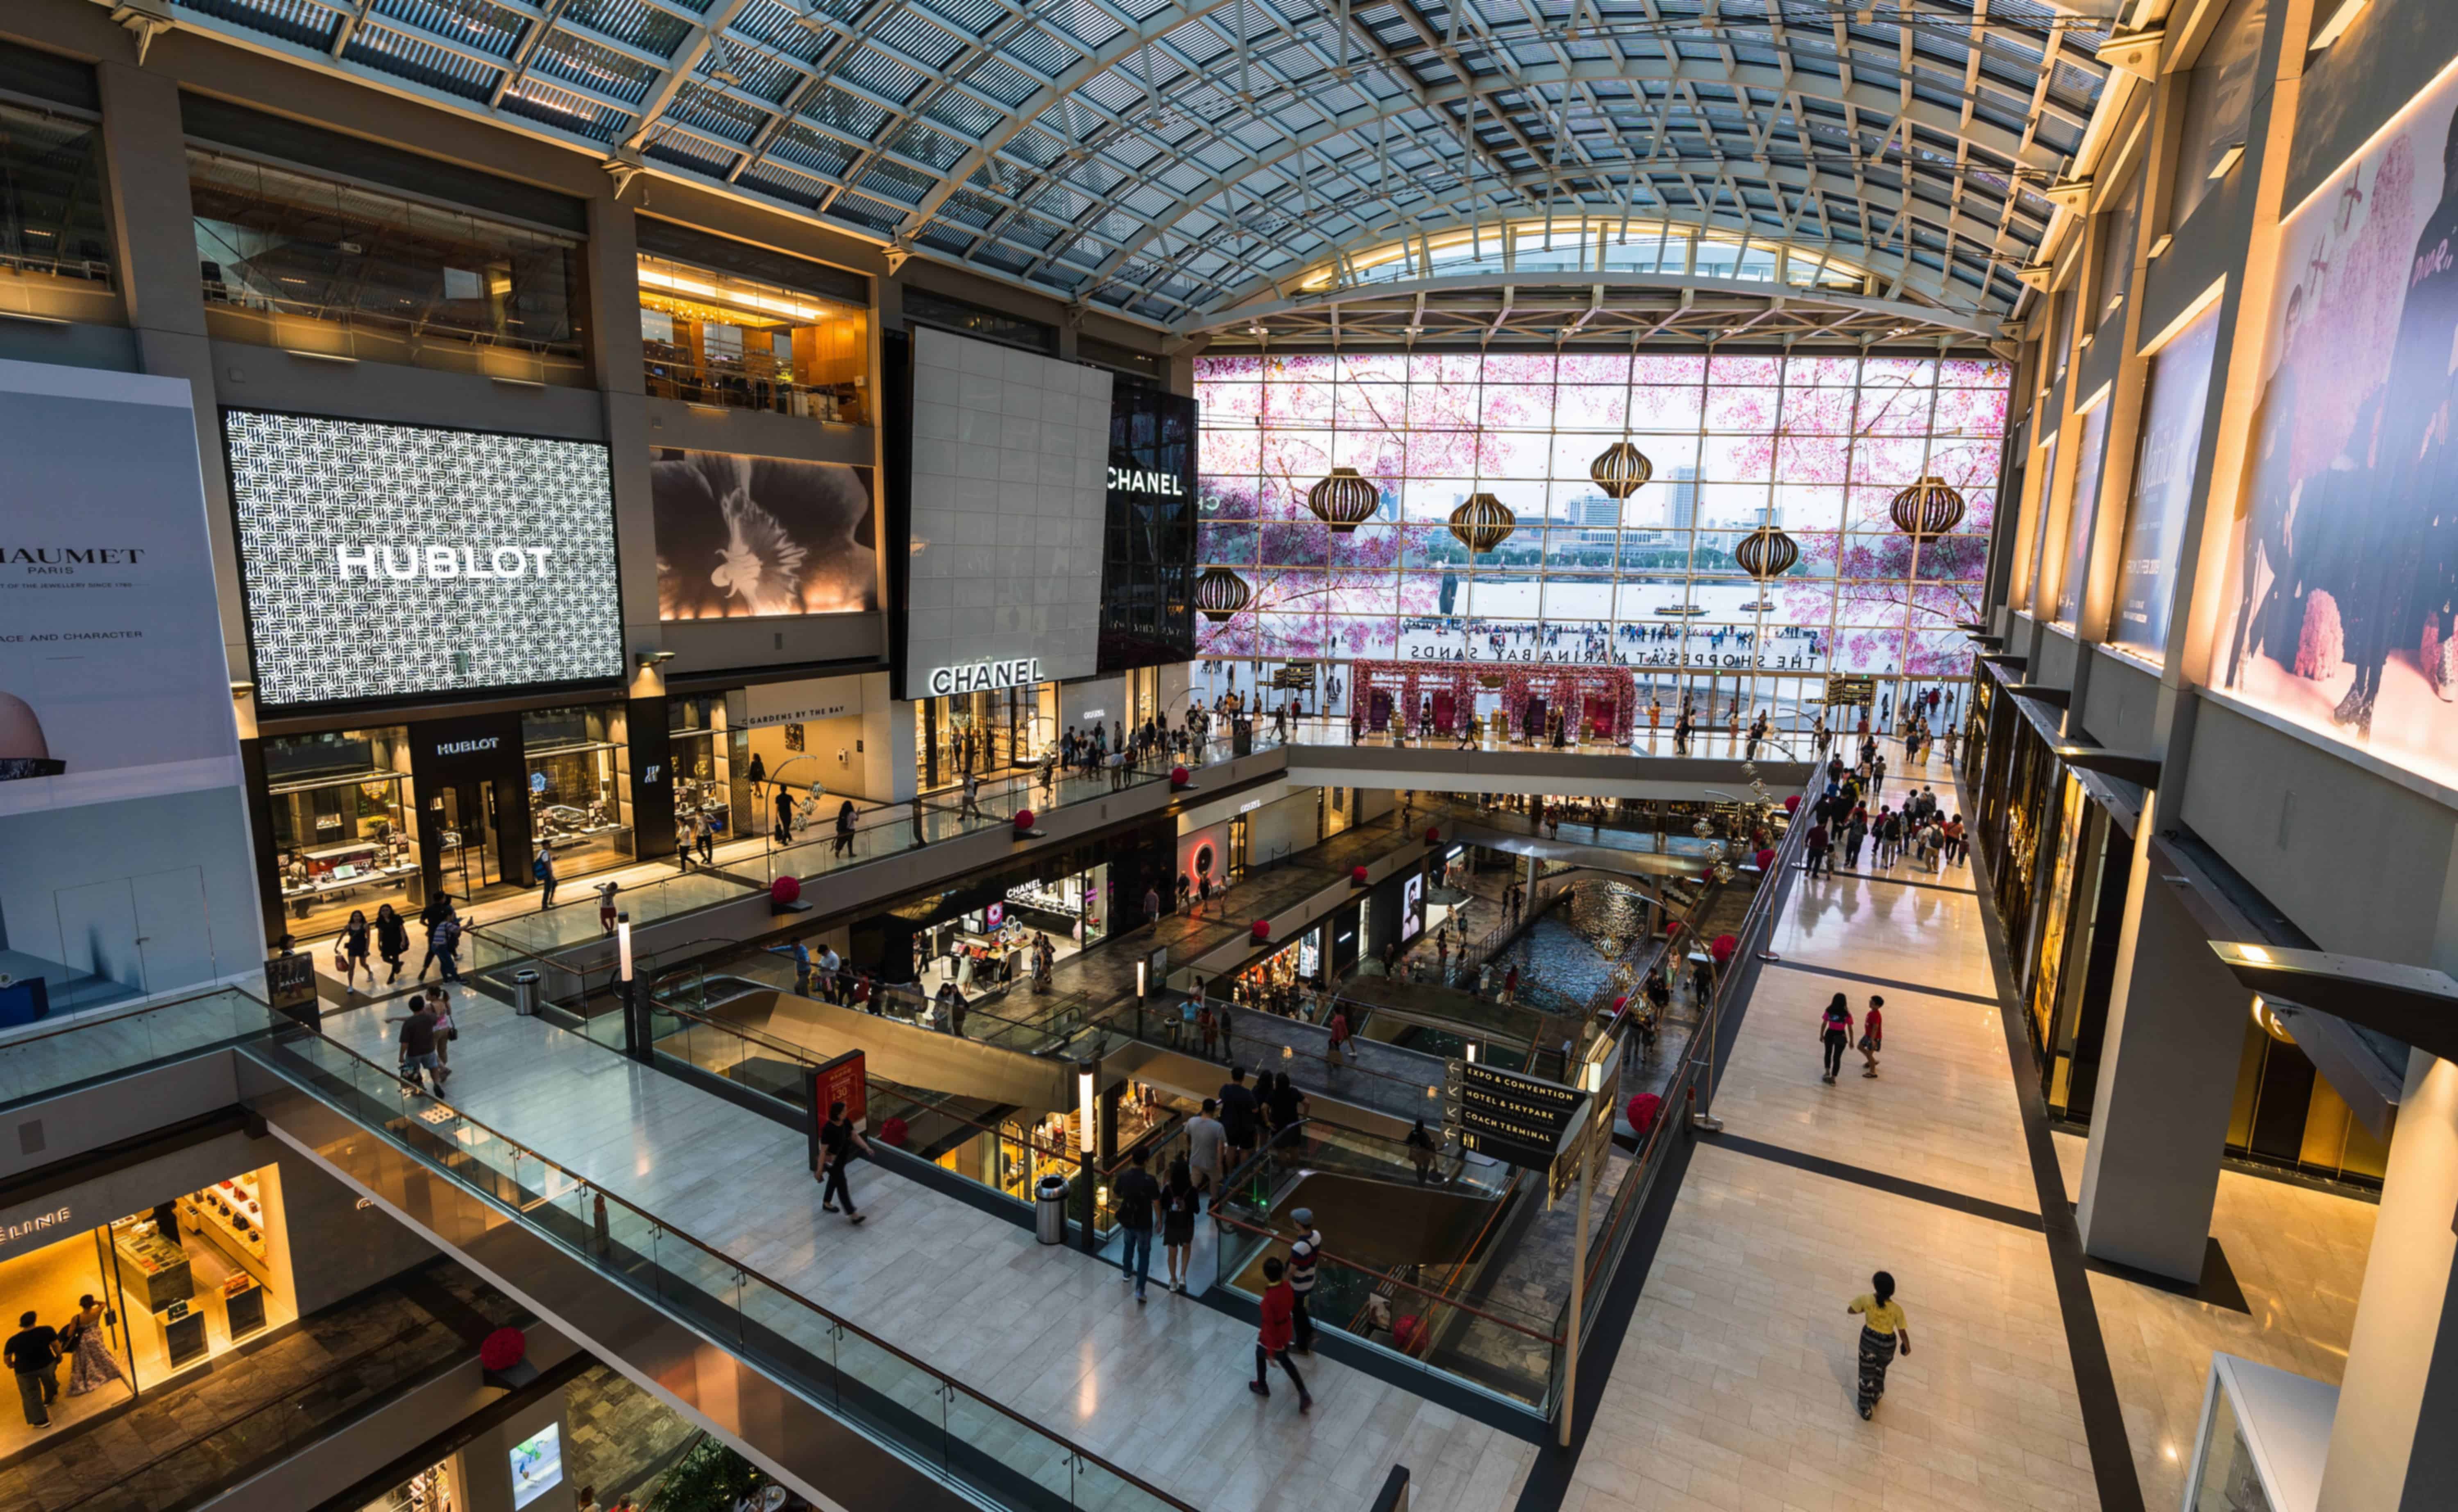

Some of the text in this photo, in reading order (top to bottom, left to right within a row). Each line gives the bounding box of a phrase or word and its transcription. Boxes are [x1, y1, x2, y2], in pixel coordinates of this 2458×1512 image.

[1107, 466, 1182, 496] CHANEL
[0, 548, 145, 564] AUMET
[338, 544, 552, 580] HUBLOT
[29, 634, 58, 643] AND
[63, 631, 143, 641] CHARACTER
[932, 659, 1045, 695] CHANEL
[750, 713, 791, 724] GARDENS
[810, 708, 825, 716] THE
[437, 737, 499, 756] HUBLOT
[1006, 878, 1042, 899] CHANEL
[1467, 1067, 1492, 1080] EXPO
[1504, 1078, 1574, 1101] CONVENTION
[1466, 1090, 1497, 1105] HOTEL
[1509, 1102, 1554, 1120] SKYPARK
[1465, 1111, 1497, 1127] COACH
[1500, 1122, 1551, 1142] TERMINAL
